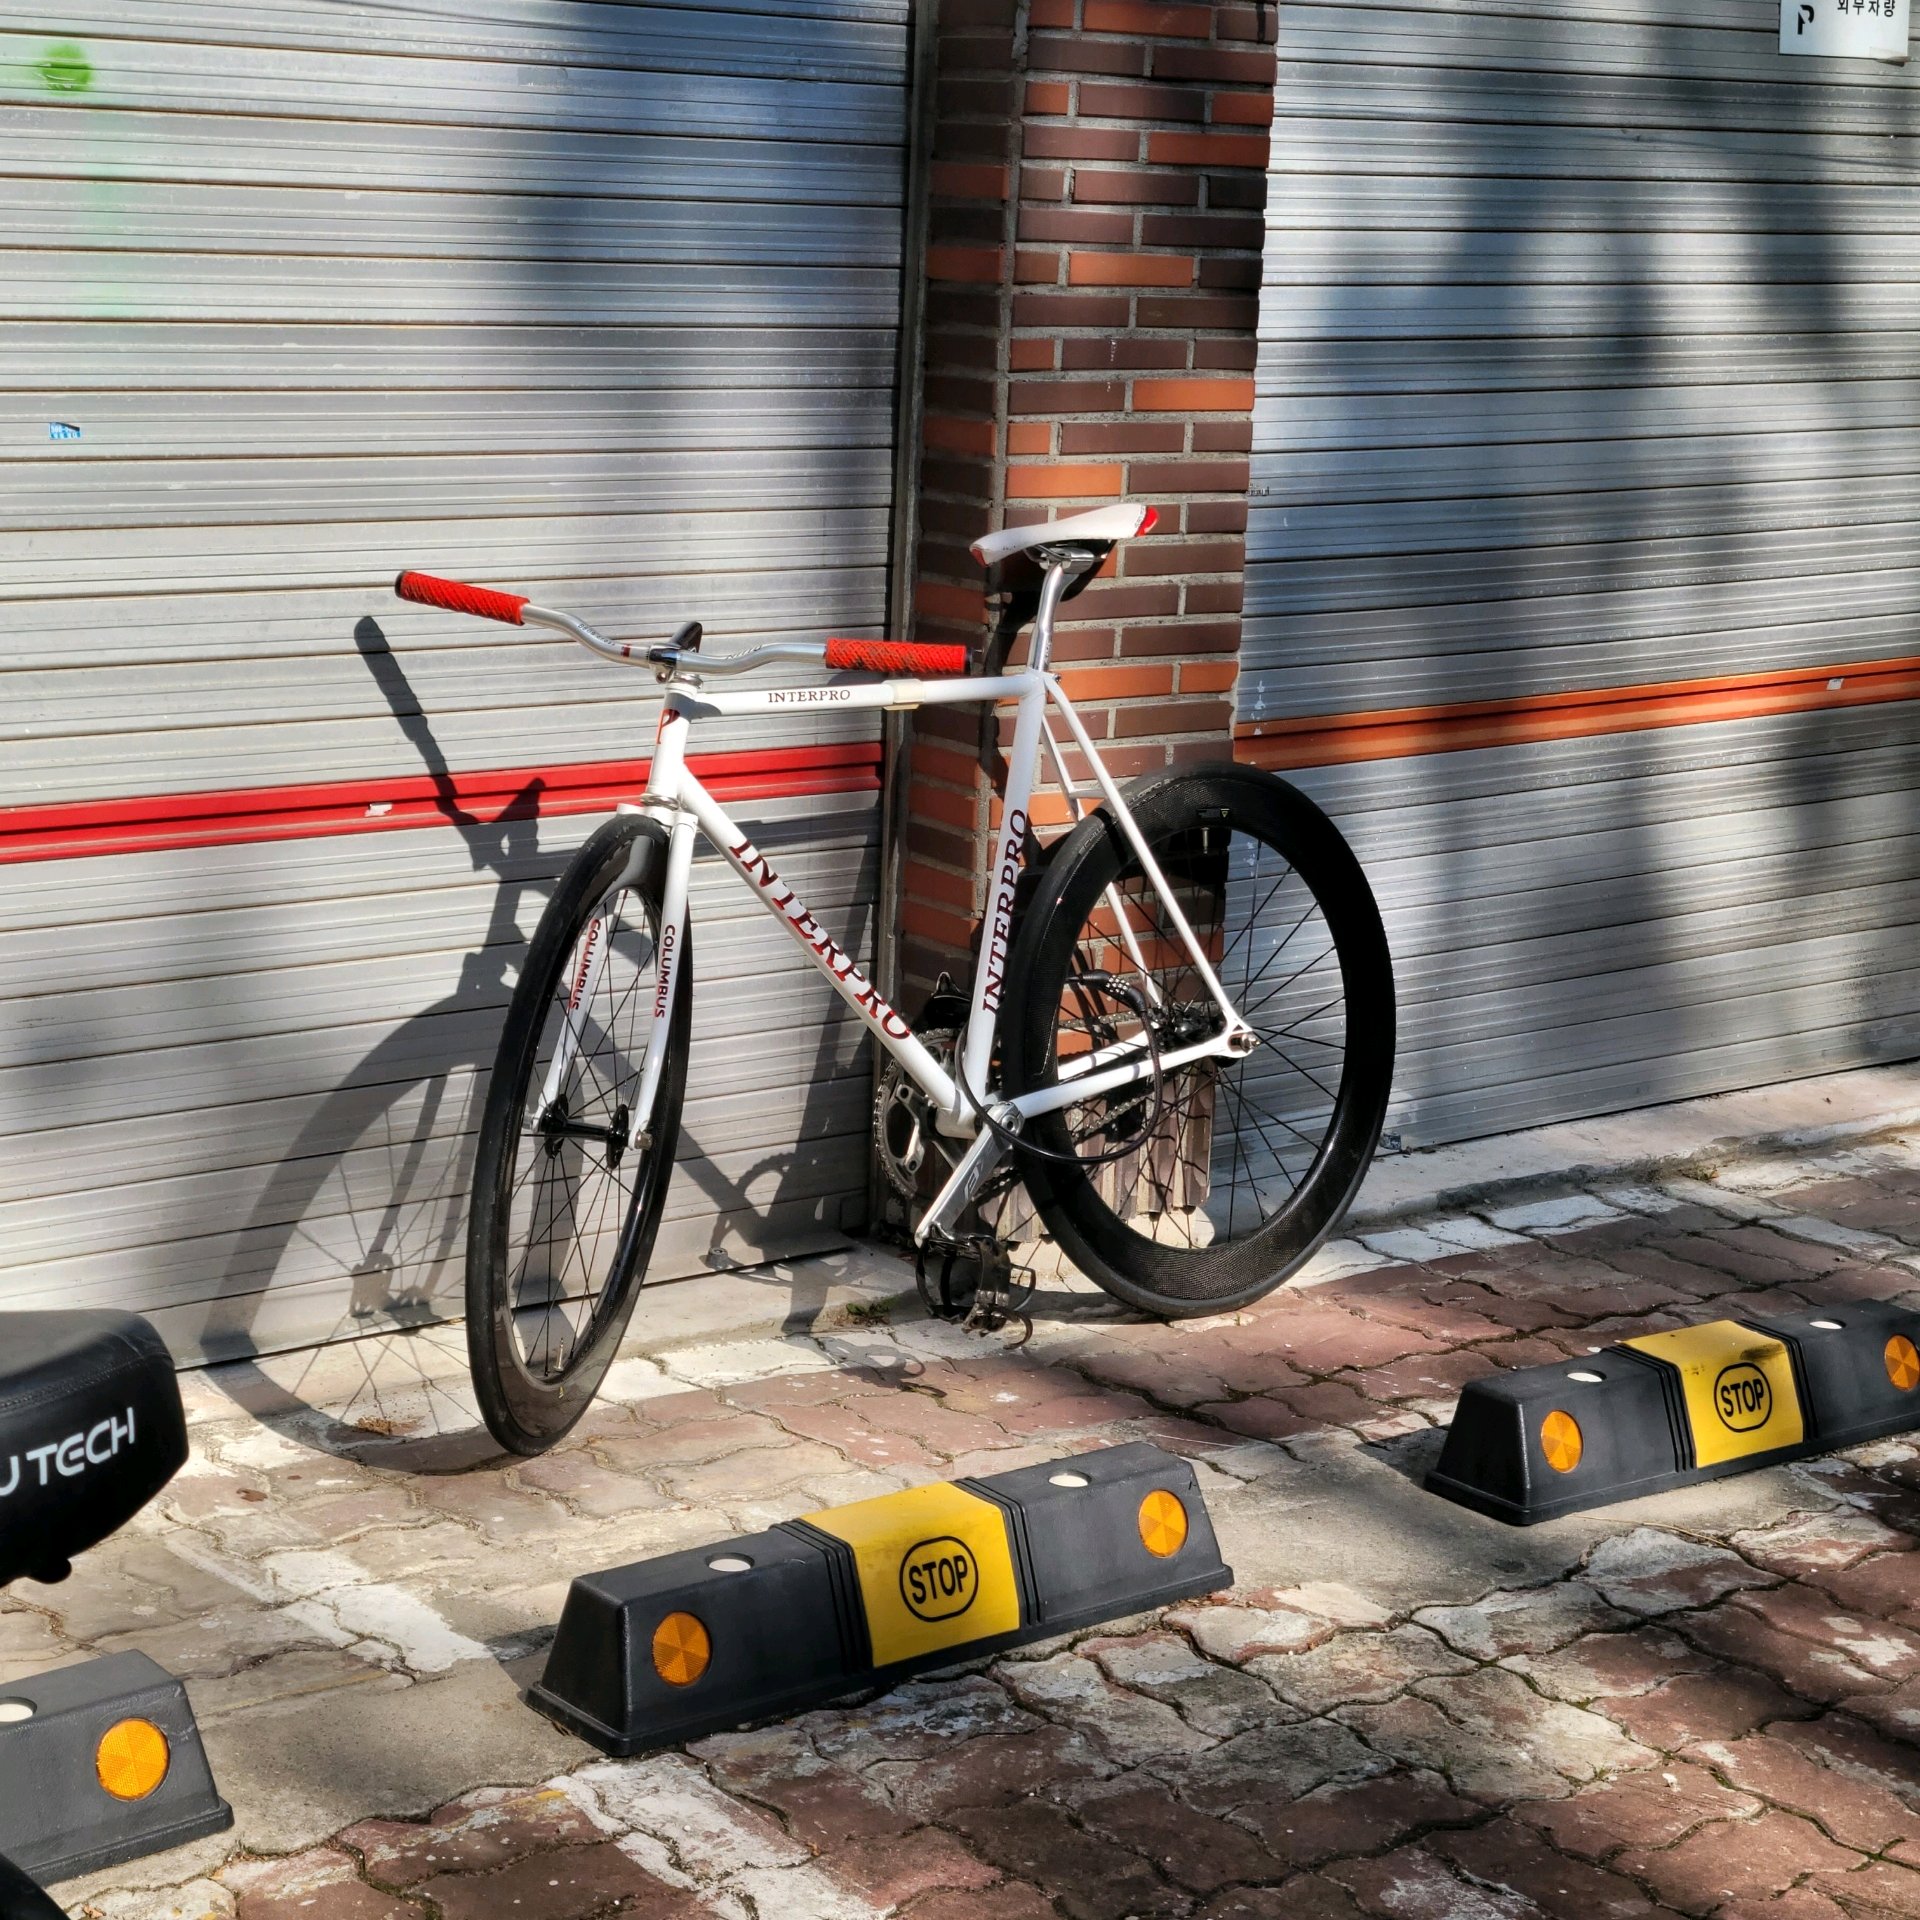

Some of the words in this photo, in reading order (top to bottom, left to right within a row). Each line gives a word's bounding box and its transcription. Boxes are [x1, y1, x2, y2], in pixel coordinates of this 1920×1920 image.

[768, 688, 851, 703] INTERPRO
[982, 808, 1028, 1015] INTERPRO
[567, 918, 602, 1011] COLUMBUS
[653, 924, 677, 1019] COLUMBUS
[1720, 1378, 1765, 1418] STOP
[908, 1554, 968, 1605] STOP
